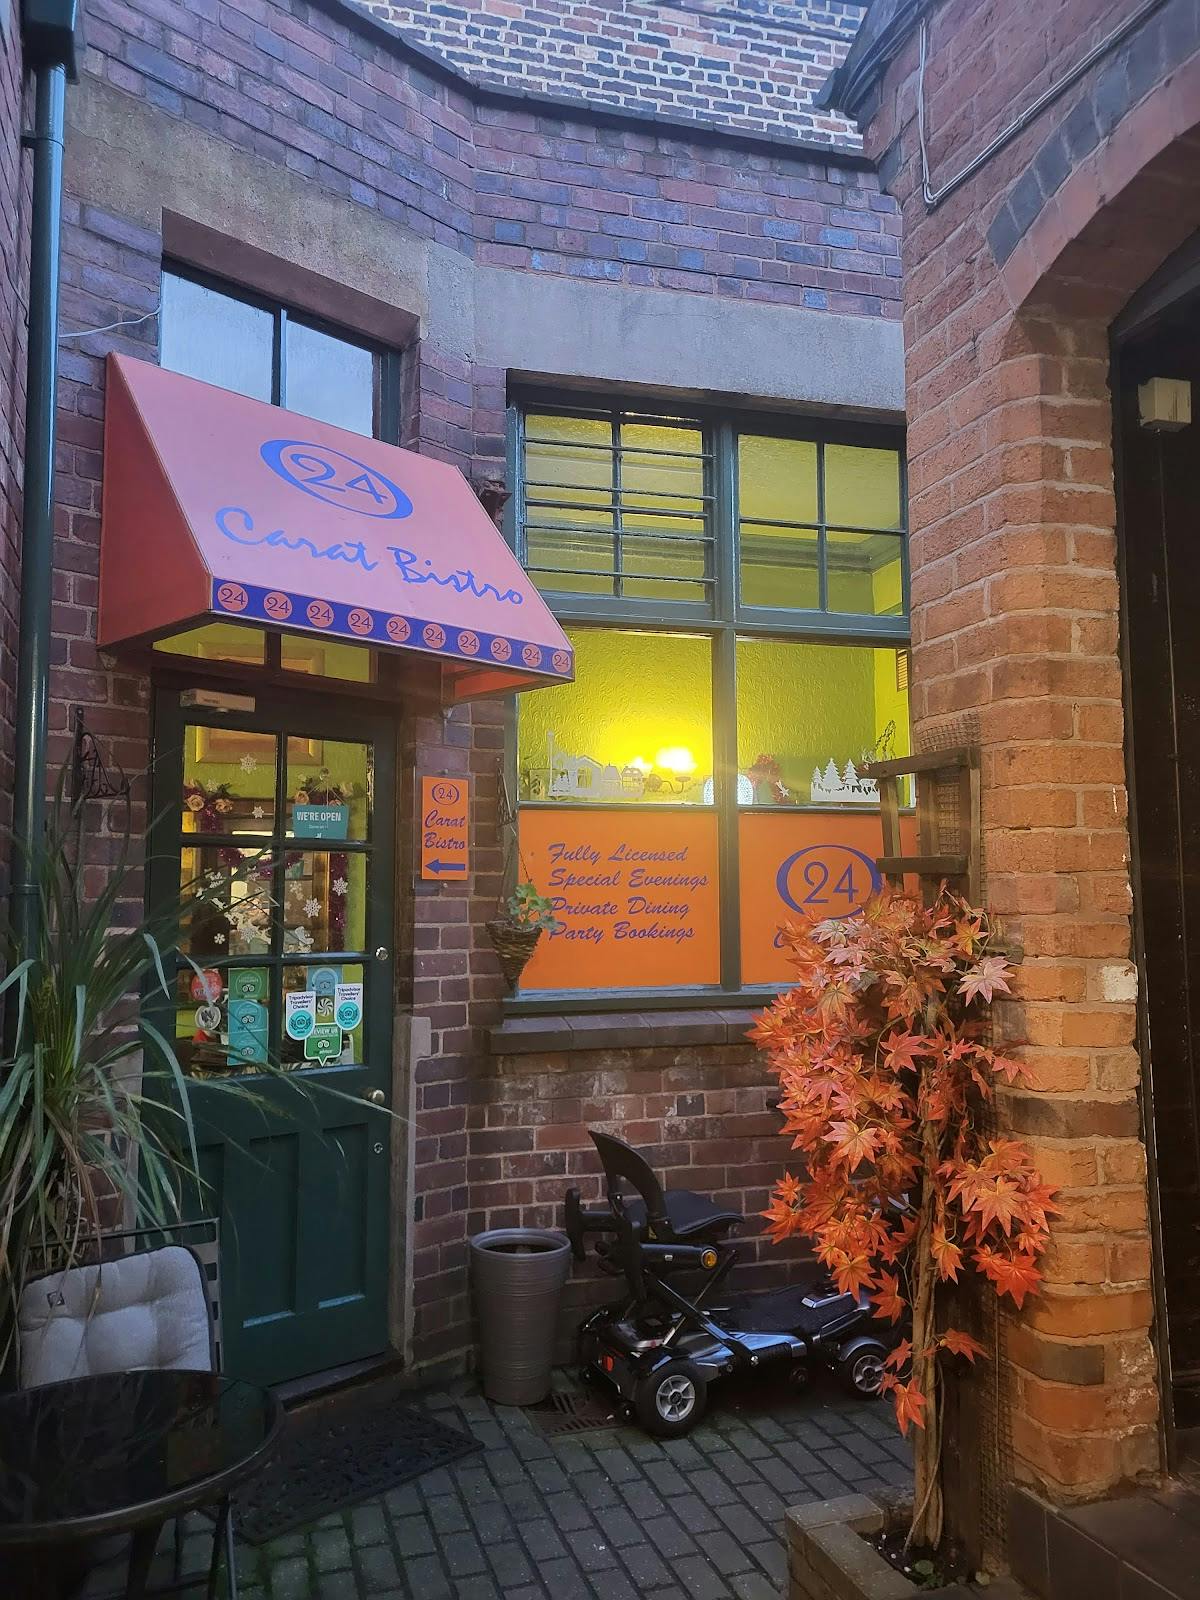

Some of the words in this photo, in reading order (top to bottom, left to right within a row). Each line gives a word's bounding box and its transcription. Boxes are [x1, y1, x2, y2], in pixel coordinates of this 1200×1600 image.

[290, 453, 388, 504] 24
[215, 506, 378, 571] Carat
[386, 546, 524, 605] Bistro
[220, 588, 246, 605] 24
[266, 597, 290, 614] 24
[309, 605, 332, 622] 24
[350, 613, 372, 629] 24
[388, 621, 409, 636] 24
[425, 628, 444, 643] 24
[460, 635, 479, 650] 24
[493, 642, 510, 657] 24
[524, 648, 540, 663] 24
[554, 654, 570, 668] 24
[438, 787, 453, 800] 24
[296, 811, 320, 821] WE'RE
[320, 811, 342, 821] OPEN
[424, 809, 466, 829] Carat
[424, 831, 465, 850] Bistro
[548, 843, 601, 865] Fully
[607, 843, 689, 862] Licensed
[548, 868, 621, 891] Special
[628, 868, 709, 892] Evenings
[803, 861, 859, 904] 24
[550, 896, 618, 916] Private
[627, 896, 691, 920] Dining
[549, 921, 604, 944] Party
[613, 921, 695, 944] Bookings
